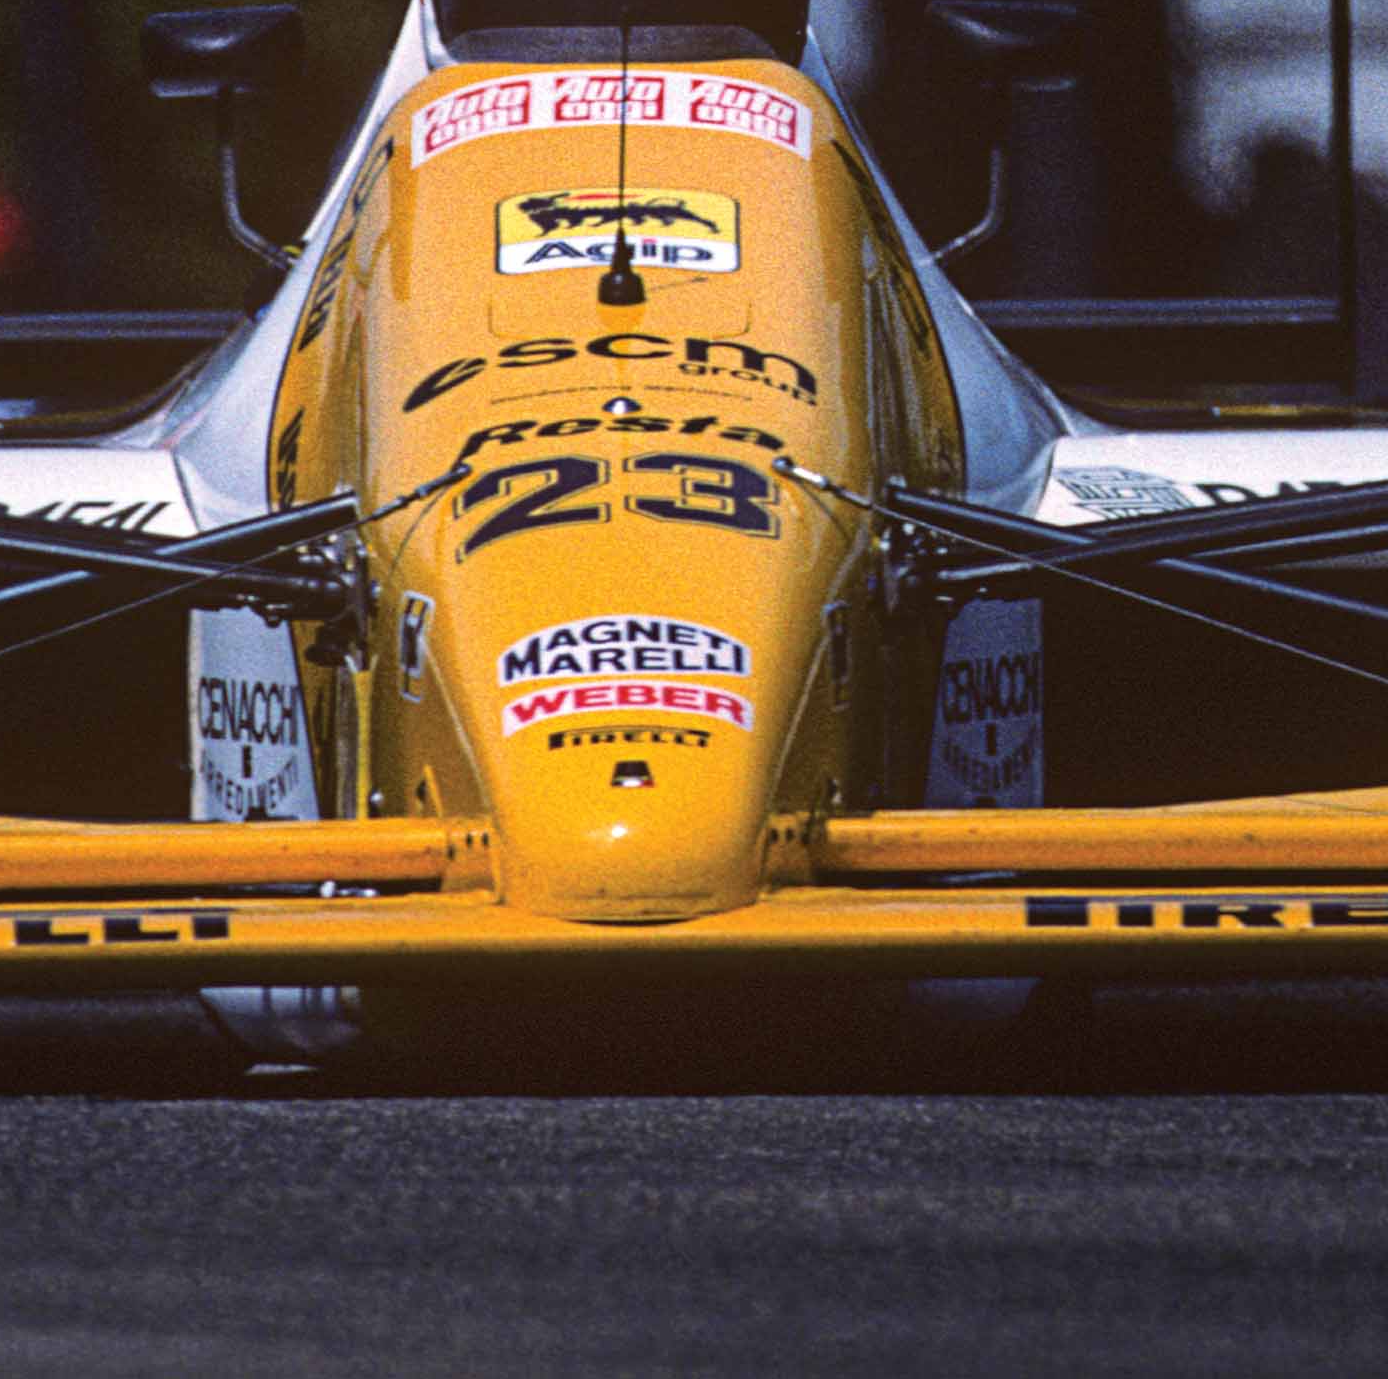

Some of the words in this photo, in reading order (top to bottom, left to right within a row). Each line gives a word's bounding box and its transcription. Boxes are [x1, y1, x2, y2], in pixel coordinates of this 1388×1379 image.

[678, 363, 817, 406] group
[454, 416, 784, 466] Resta
[452, 451, 781, 563] 23
[504, 620, 745, 676] MAGNETI
[504, 638, 745, 681] MARELLI
[511, 685, 745, 724] WEBER
[548, 724, 711, 750] PIRELLI
